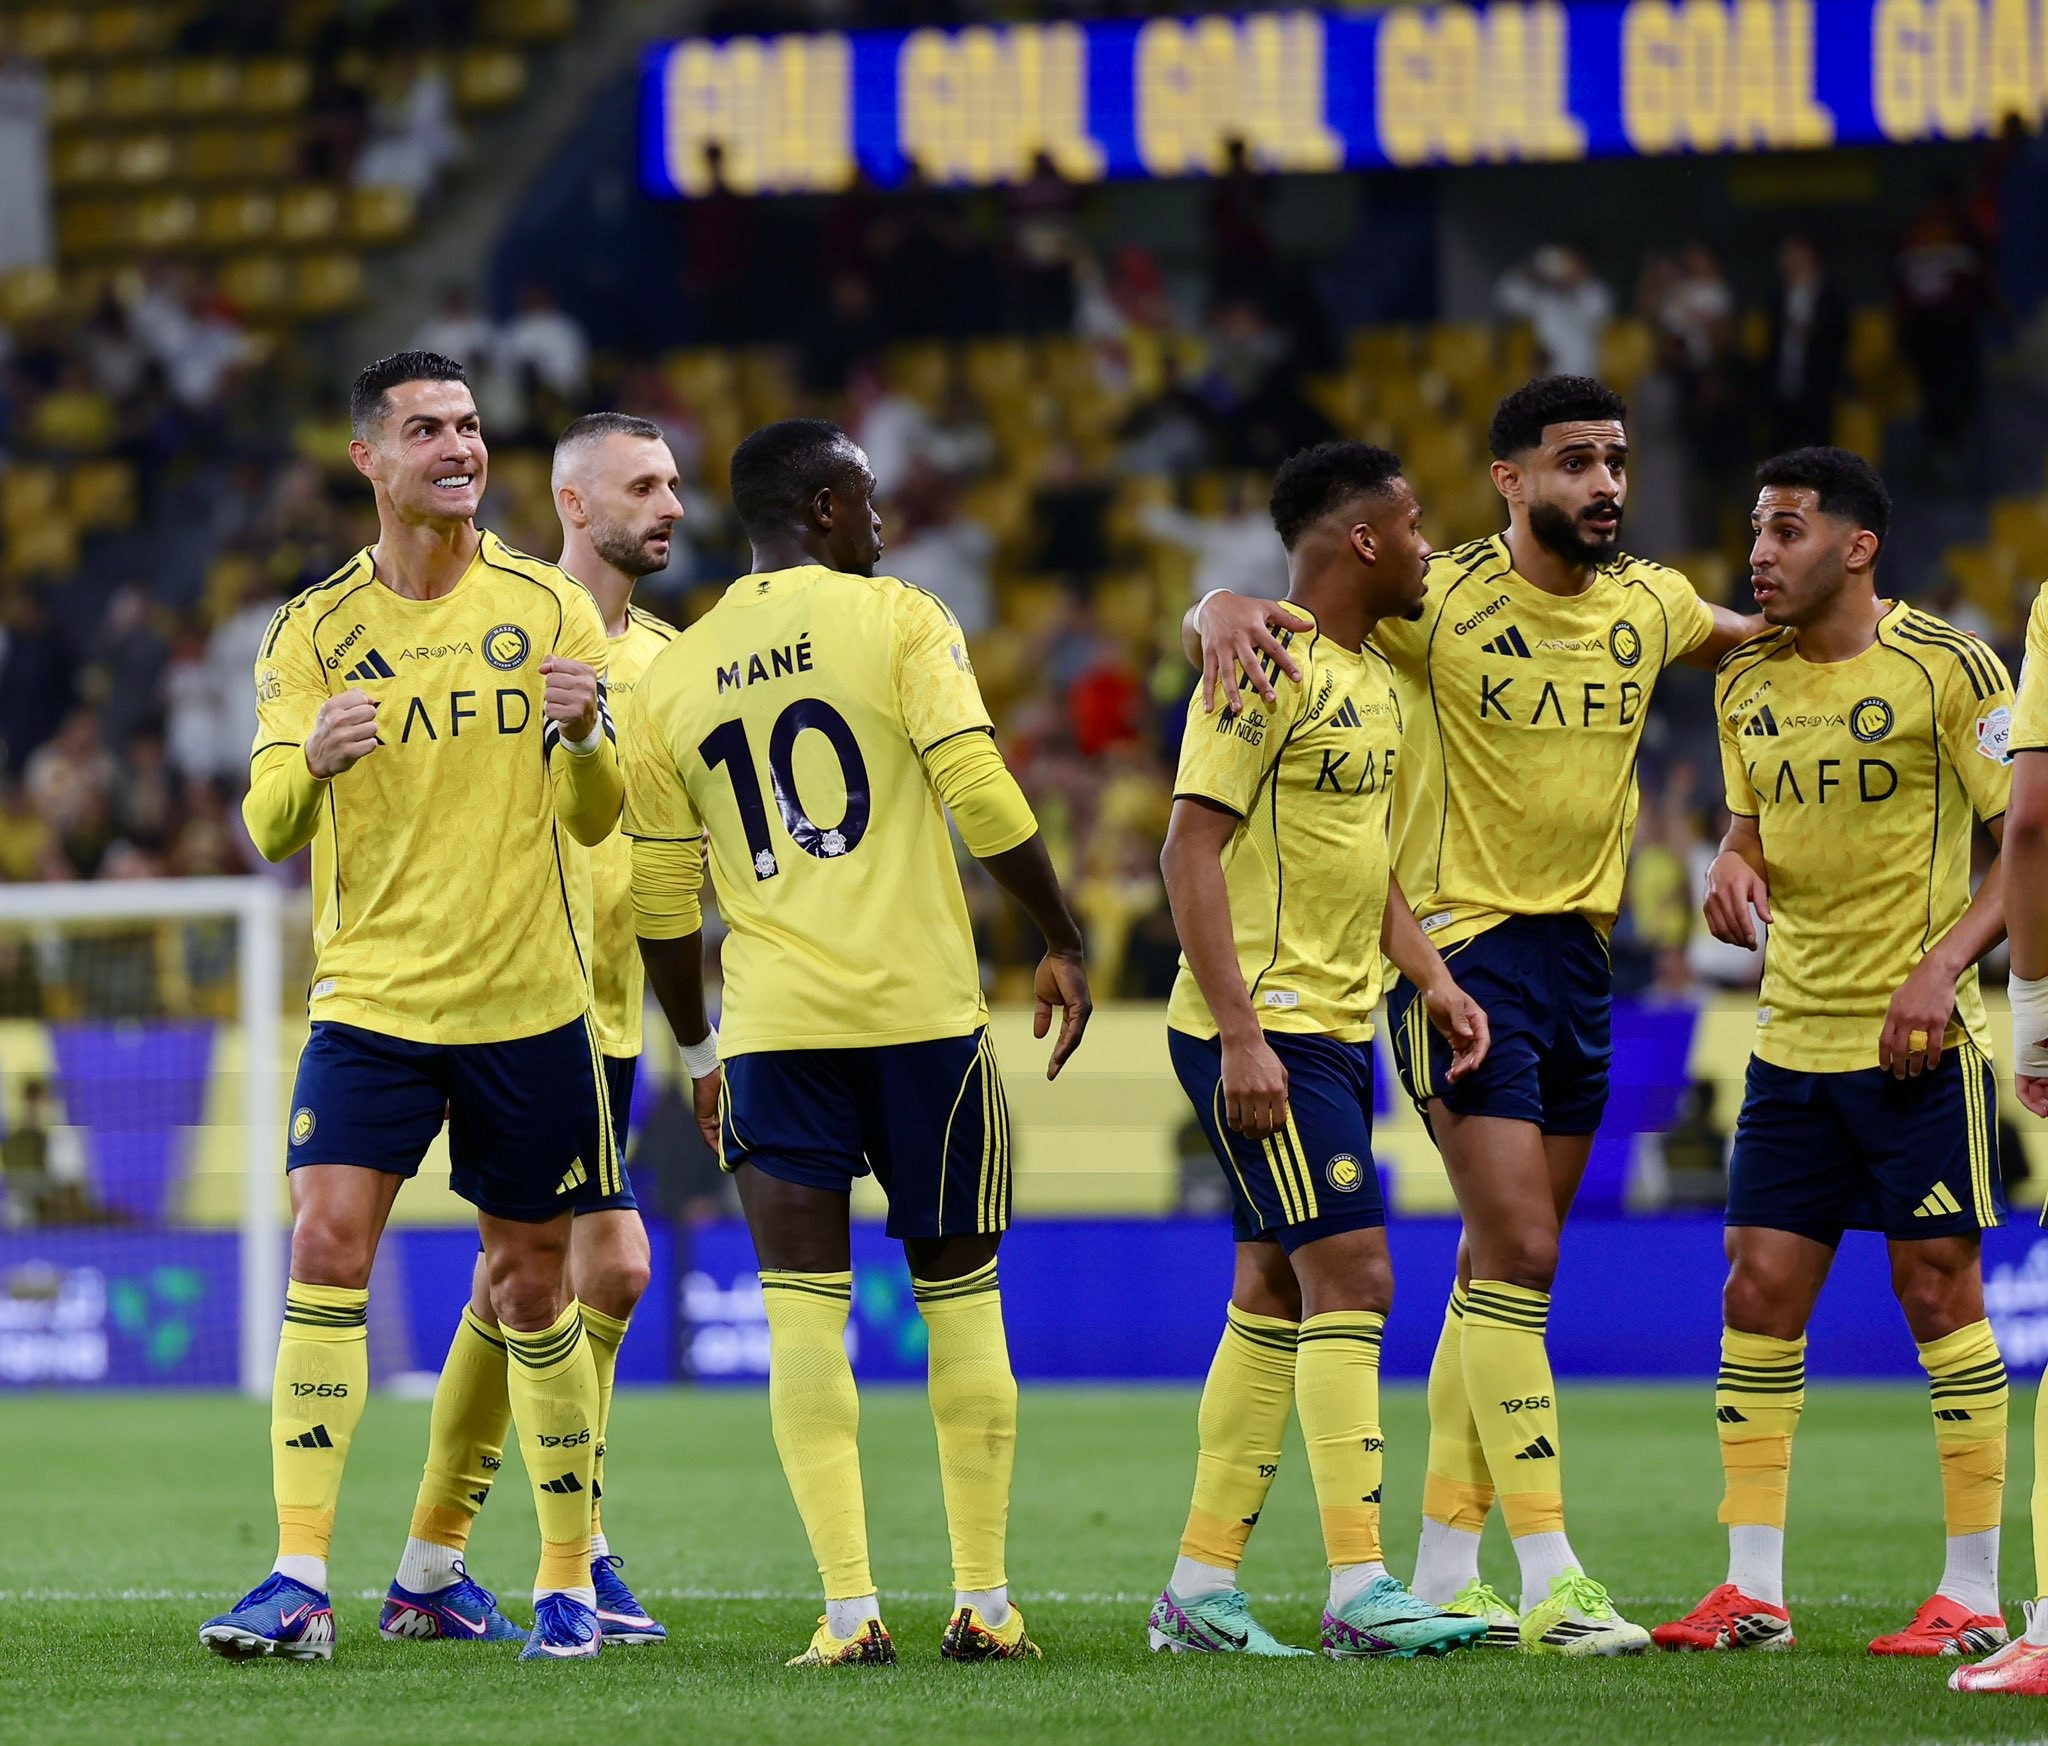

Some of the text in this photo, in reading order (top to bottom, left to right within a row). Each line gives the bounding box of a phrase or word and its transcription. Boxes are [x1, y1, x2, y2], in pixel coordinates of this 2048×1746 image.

[1376, 0, 1588, 166] GOAL
[1621, 0, 1836, 154] GOAL
[1872, 0, 2048, 142] GOA
[1454, 594, 1511, 636] Gathern
[326, 623, 366, 670] Gthern
[716, 632, 814, 695] MANÉ
[606, 681, 636, 694] ROY
[1309, 669, 1334, 720] Gathern
[1480, 674, 1641, 727] KAFD
[1234, 722, 1263, 746] NOUG
[1781, 714, 1846, 728] AROYA
[1994, 728, 2010, 744] RS
[697, 698, 871, 881] 10
[1314, 749, 1395, 794] KAF
[290, 1383, 348, 1397] 1955
[1499, 1395, 1550, 1414] 1955
[536, 1428, 590, 1448] 1955
[481, 1456, 501, 1471] 195
